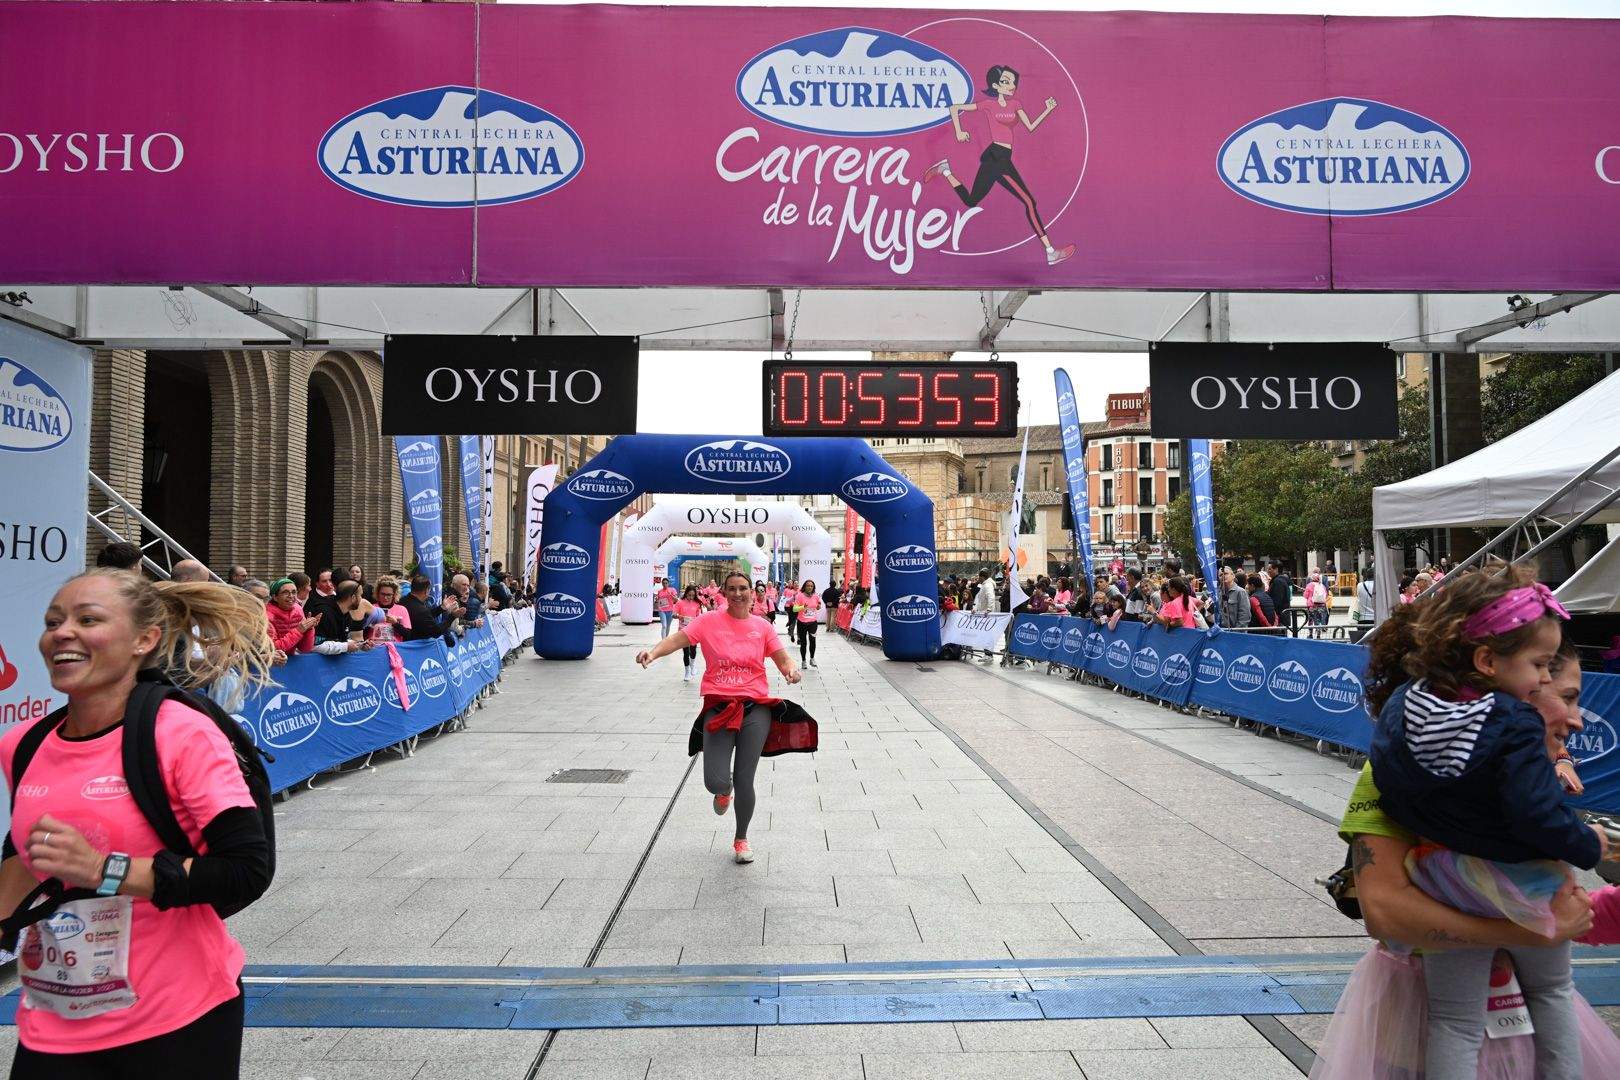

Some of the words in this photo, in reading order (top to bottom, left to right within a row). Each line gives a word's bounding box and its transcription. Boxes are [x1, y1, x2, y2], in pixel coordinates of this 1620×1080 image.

[792, 64, 865, 75] CENTRAL
[874, 65, 947, 77] LECHERA
[755, 66, 957, 109] ASTURIANA
[381, 128, 466, 139] CENTRAL
[471, 128, 555, 140] LECHERA
[338, 130, 563, 175] ASTURIANA
[1277, 138, 1354, 150] CENTRAL
[1363, 139, 1442, 150] LECHERA
[716, 127, 910, 185] Carrera
[1237, 141, 1451, 184] ASTURIANA
[763, 188, 798, 226] de
[808, 187, 833, 227] la
[827, 181, 985, 275] Mujer
[424, 367, 602, 404] OYSHO
[1190, 375, 1362, 411] OYSHO
[17, 393, 60, 411] LECHERA
[1110, 399, 1143, 410] TIBUR
[693, 453, 783, 474] ASTURIANA
[571, 482, 629, 494] ASTURIANA
[848, 483, 904, 496] ASTURIANA
[687, 507, 769, 525] OYSHO
[541, 553, 587, 565] ASTURIANA
[889, 554, 934, 566] ASTURIANA
[889, 605, 936, 617] ASTURIANA
[716, 675, 744, 685] SUMA
[1229, 667, 1262, 685] ASTURIANA
[1270, 673, 1306, 694] ASTURIANA
[1314, 680, 1358, 704] ASTURIANA
[330, 694, 379, 718] ASTURIANA
[265, 711, 319, 740] ASTURIANA
